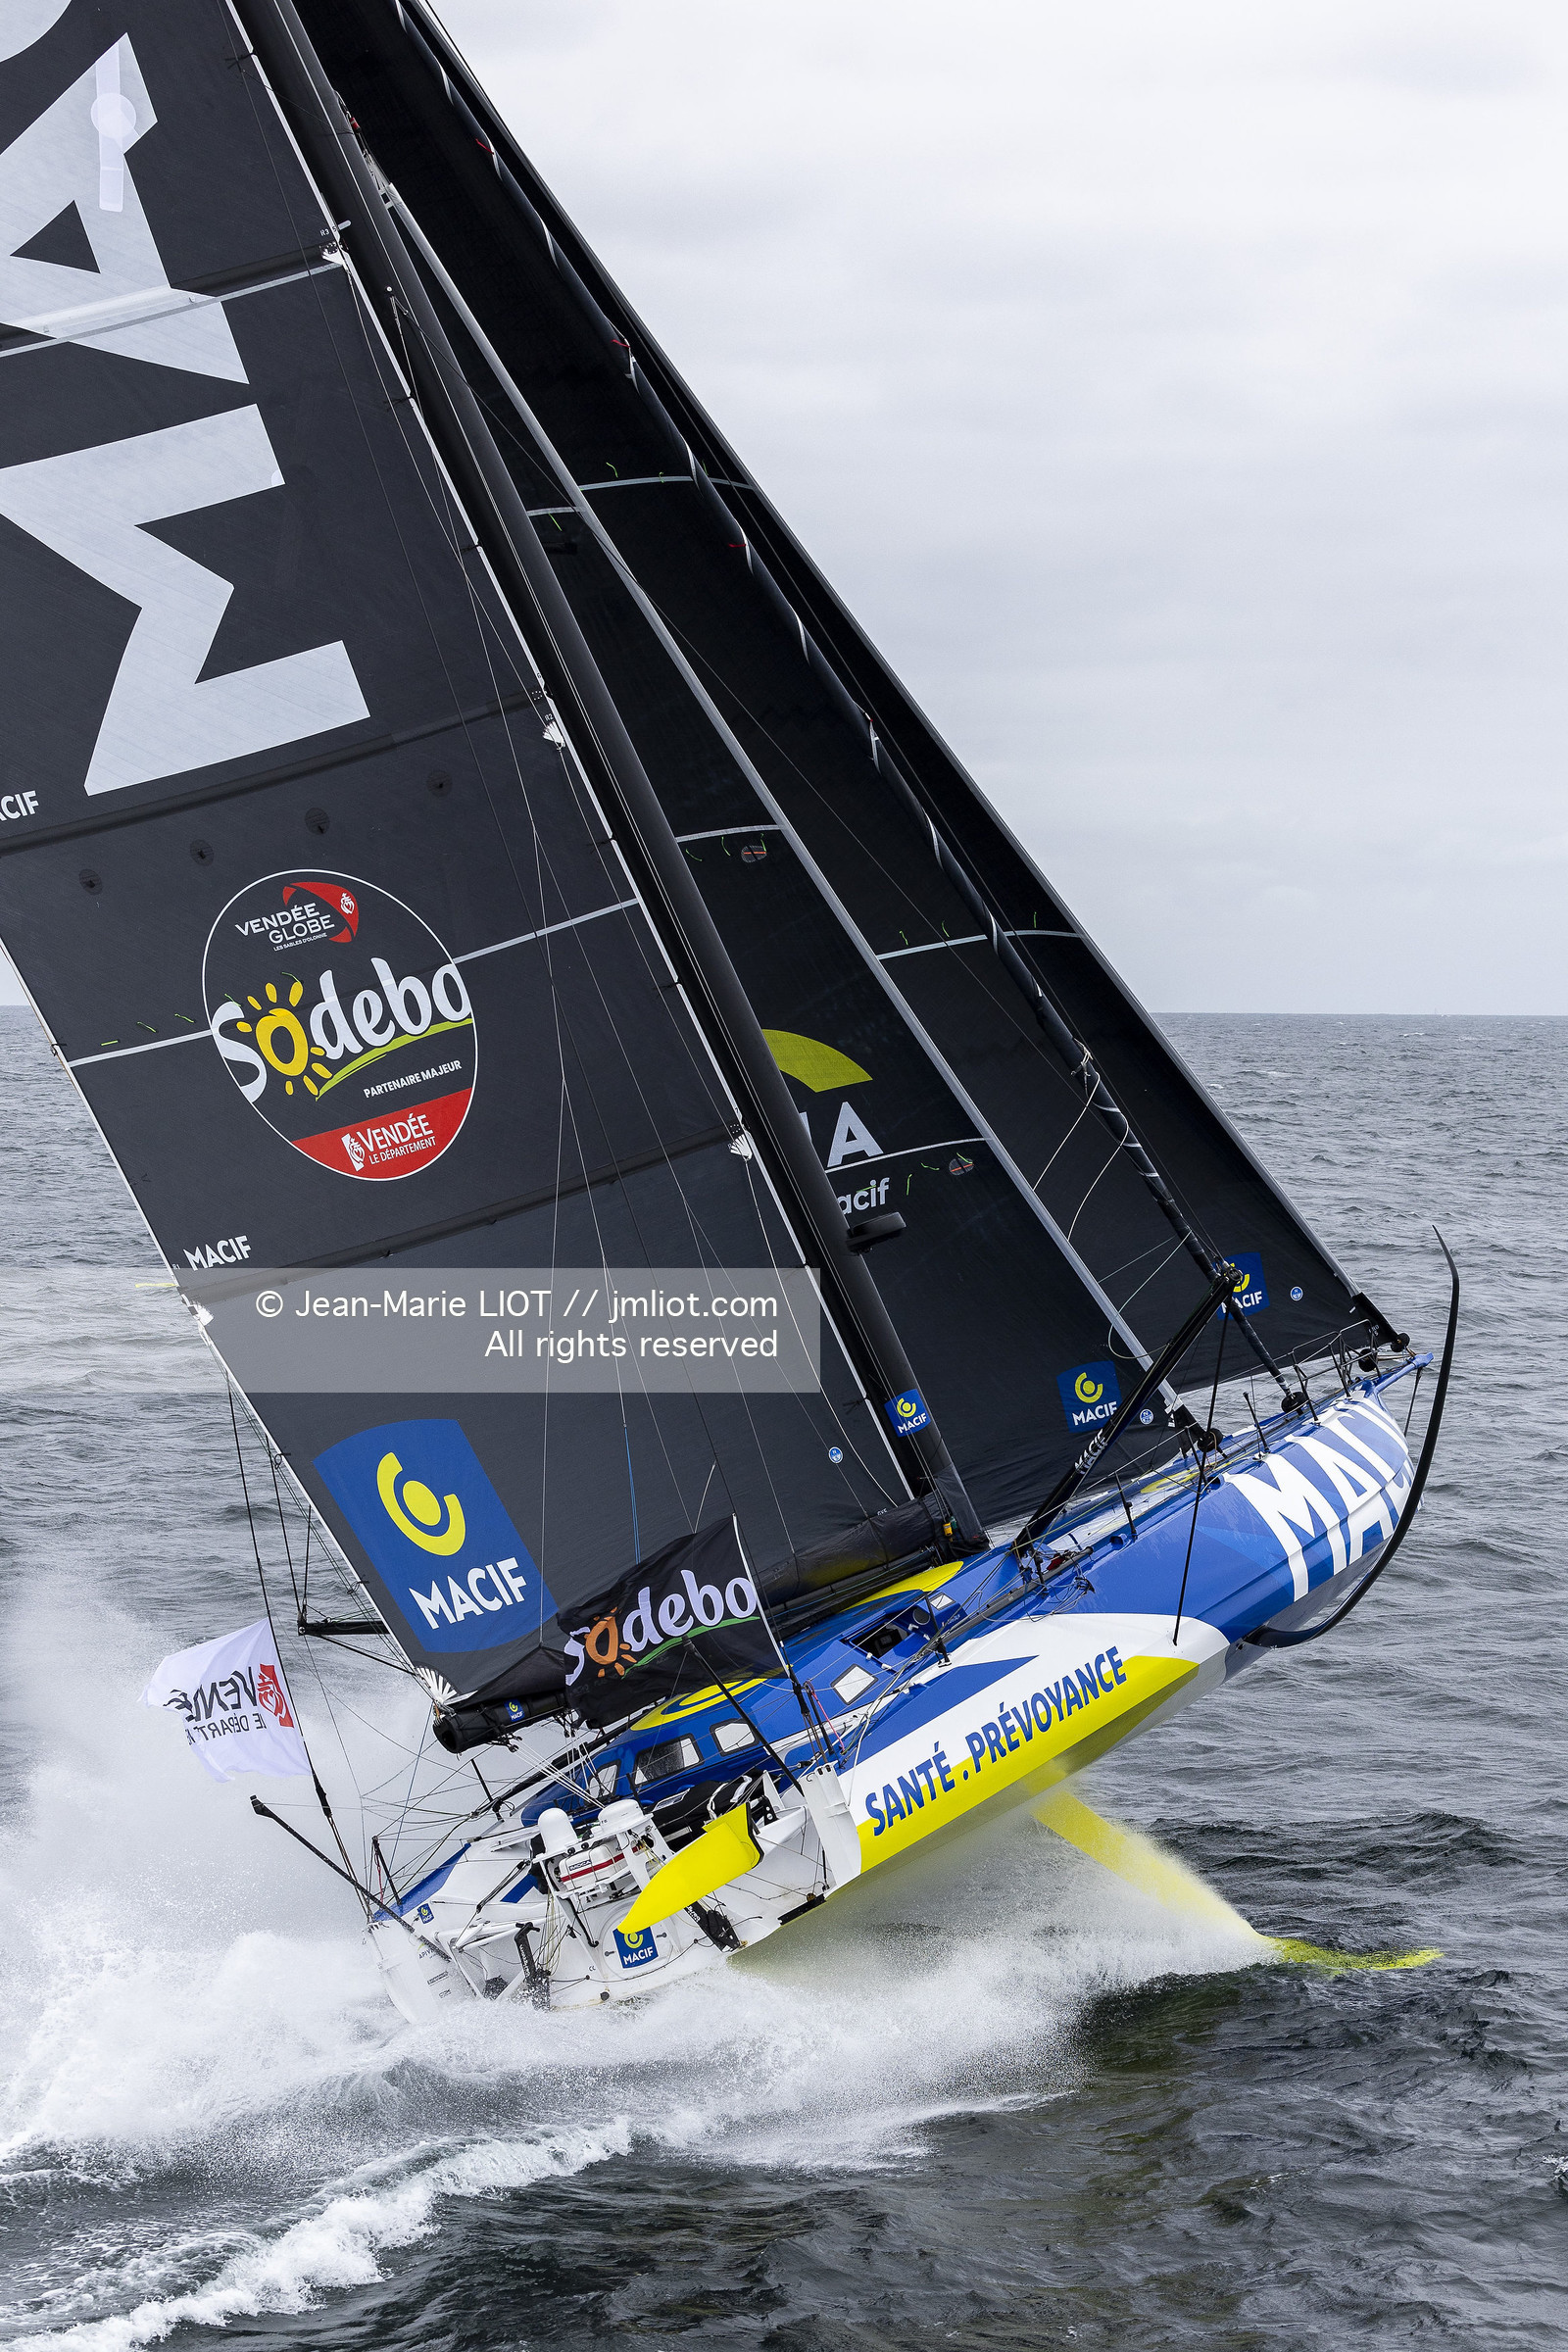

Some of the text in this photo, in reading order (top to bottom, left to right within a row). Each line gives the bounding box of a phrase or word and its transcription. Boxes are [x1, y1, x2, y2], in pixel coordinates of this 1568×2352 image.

[234, 902, 320, 936] VENDÉE
[269, 913, 335, 944] GLOBE
[212, 956, 472, 1103] Sodebo
[363, 1059, 463, 1099] PARTENAIRE MAJEUR
[356, 1112, 434, 1152] VENDÉE
[368, 1136, 436, 1165] LE DÉPARTEMENT
[799, 1101, 884, 1168] A
[182, 1235, 252, 1272] MACIF
[897, 1412, 927, 1434] MACIF
[1071, 1400, 1118, 1426] MACIF
[408, 1556, 527, 1630] MACIF
[864, 1740, 956, 1837] SANTÉ
[964, 1645, 1128, 1774] PRÉVOYANCE
[622, 1945, 654, 1965] MACIF
